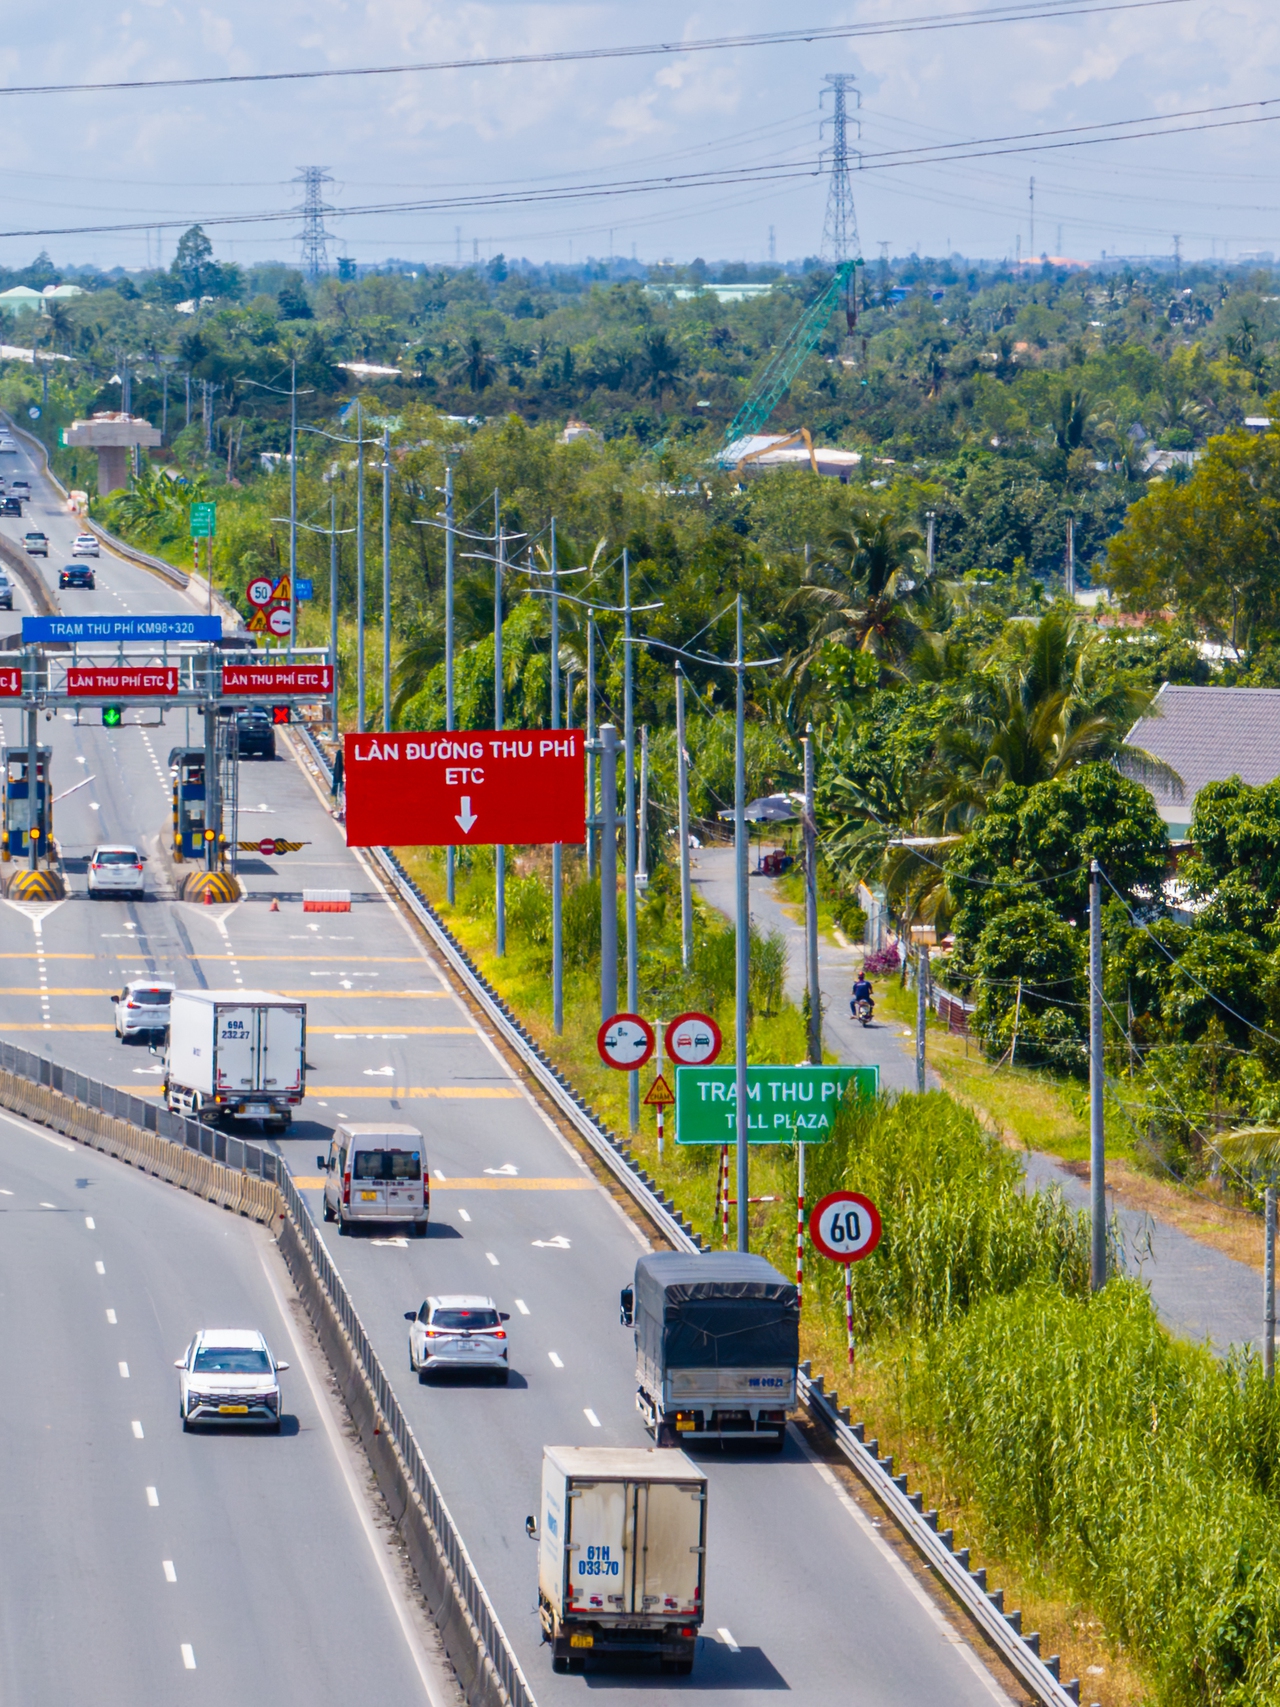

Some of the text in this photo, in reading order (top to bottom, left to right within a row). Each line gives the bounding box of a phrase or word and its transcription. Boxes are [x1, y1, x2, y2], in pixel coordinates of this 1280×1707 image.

[255, 586, 268, 599] 50
[50, 620, 194, 637] TRẠM THU PHÍ KM98+320
[70, 673, 164, 687] LÀN THU PHÍ ETC
[224, 671, 319, 685] LÀN THU PHÍ ETC
[354, 735, 575, 761] LÀN ĐƯỜNG THU PHÍ
[445, 767, 485, 785] ETC
[228, 1020, 244, 1029] 69A
[768, 1082, 814, 1102] THU
[725, 1114, 829, 1129] TLL PLAZA
[830, 1211, 861, 1243] 60
[587, 1545, 610, 1561] 61H
